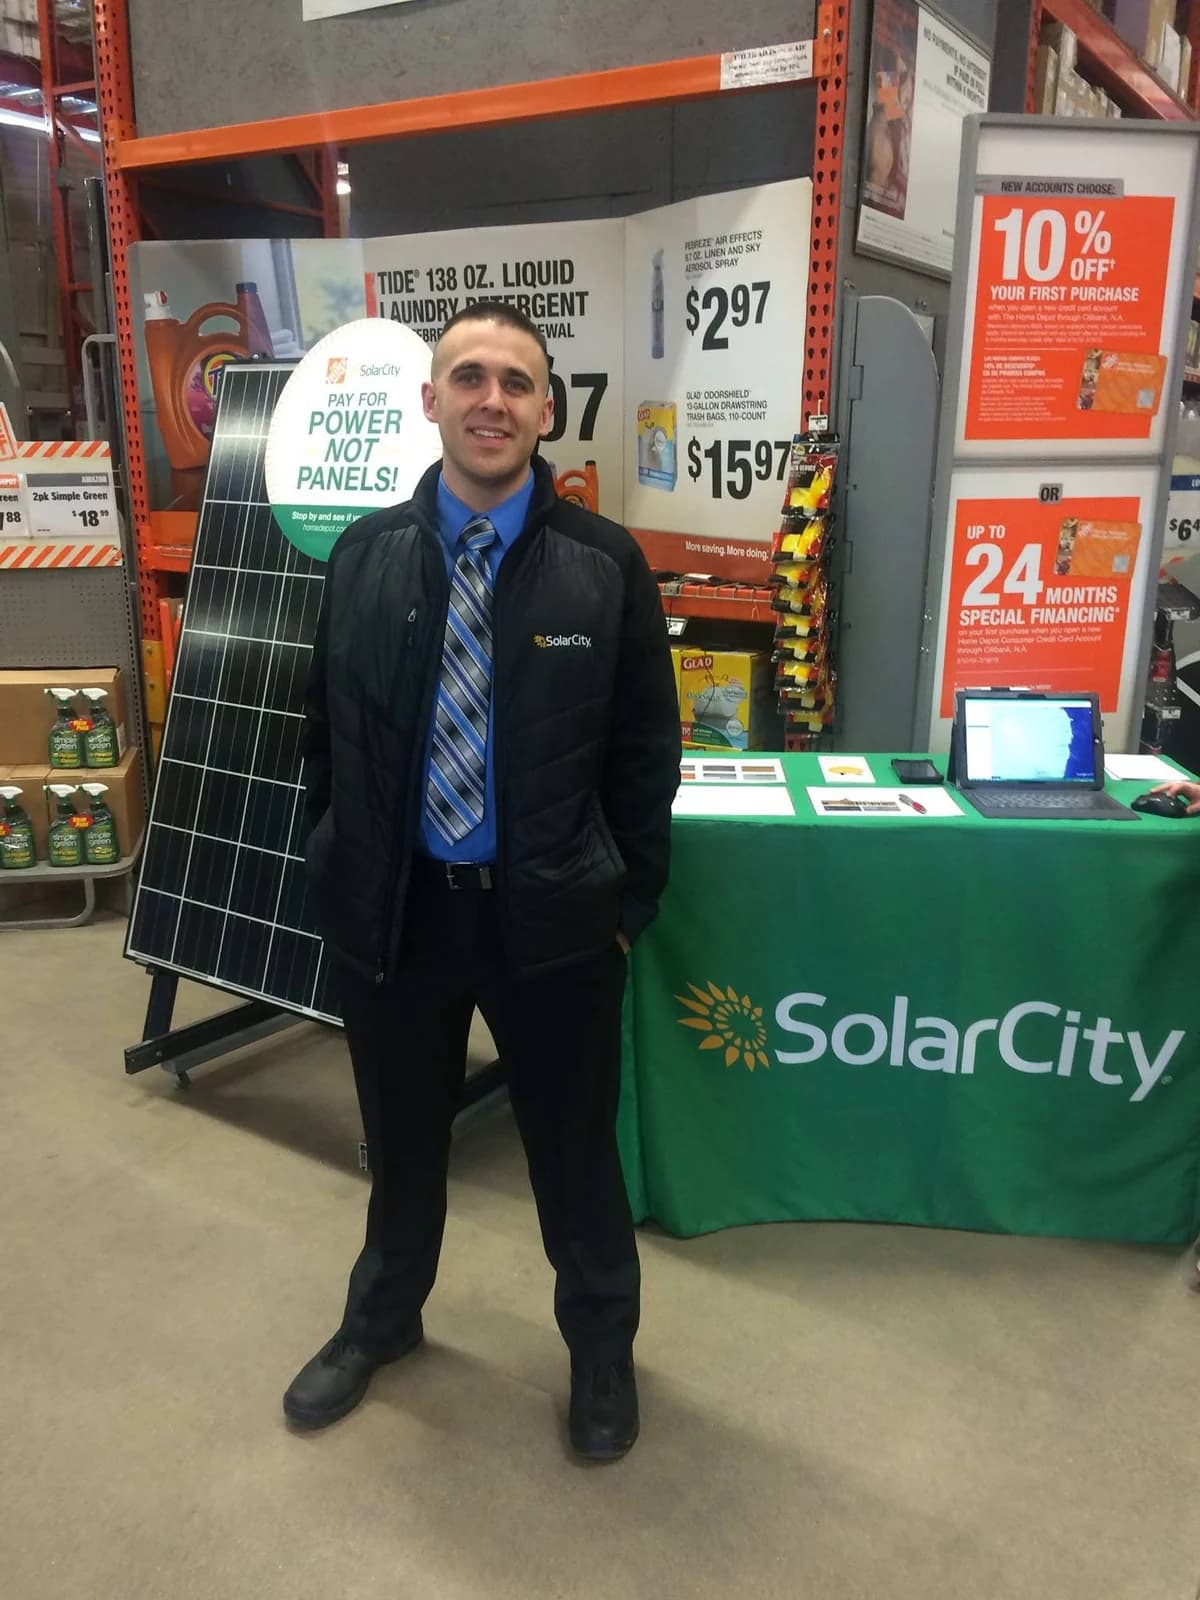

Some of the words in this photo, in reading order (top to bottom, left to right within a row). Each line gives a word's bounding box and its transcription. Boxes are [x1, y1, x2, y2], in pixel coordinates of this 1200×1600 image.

[1001, 181, 1022, 193] NEW
[1025, 182, 1074, 194] ACCOUNTS
[1076, 183, 1115, 195] CHOOSE:
[715, 234, 727, 245] AIR
[729, 231, 762, 243] EFFECTS
[704, 247, 726, 259] LINEN
[727, 245, 744, 255] AND
[745, 243, 761, 253] SKY
[715, 257, 739, 269] SPRAY
[426, 267, 458, 292] 138
[463, 264, 494, 289] OZ.
[502, 259, 574, 288] LIQUID
[990, 285, 1025, 300] YOUR
[1029, 286, 1067, 301] FIRST
[1070, 286, 1139, 302] PURCHASE
[380, 297, 459, 324] LAUNDRY
[360, 363, 400, 377] SolarCity
[328, 393, 353, 407] PAY
[358, 392, 388, 407] FOR
[720, 400, 767, 410] DRAWSTRING
[308, 409, 402, 435] POWER
[686, 412, 704, 421] TRASH
[728, 411, 766, 421] 110-COUNT
[324, 438, 380, 463] NOT
[296, 466, 399, 492] PANELS!
[32, 492, 49, 502] 2pk
[51, 491, 81, 502] Simple
[83, 491, 108, 501] Green
[1040, 486, 1060, 502] OR
[292, 511, 308, 521] Stop
[309, 512, 317, 522] by
[318, 512, 331, 521] and
[967, 525, 985, 539] UP
[989, 525, 1005, 539] TO
[685, 541, 701, 552] More
[726, 545, 744, 556] More
[961, 543, 1043, 606] 24
[1046, 586, 1118, 604] MONTHS
[959, 606, 1025, 626] SPECIAL
[545, 634, 591, 648] SolarCity
[683, 656, 712, 669] GLAD
[774, 990, 1186, 1102] SolarCity
